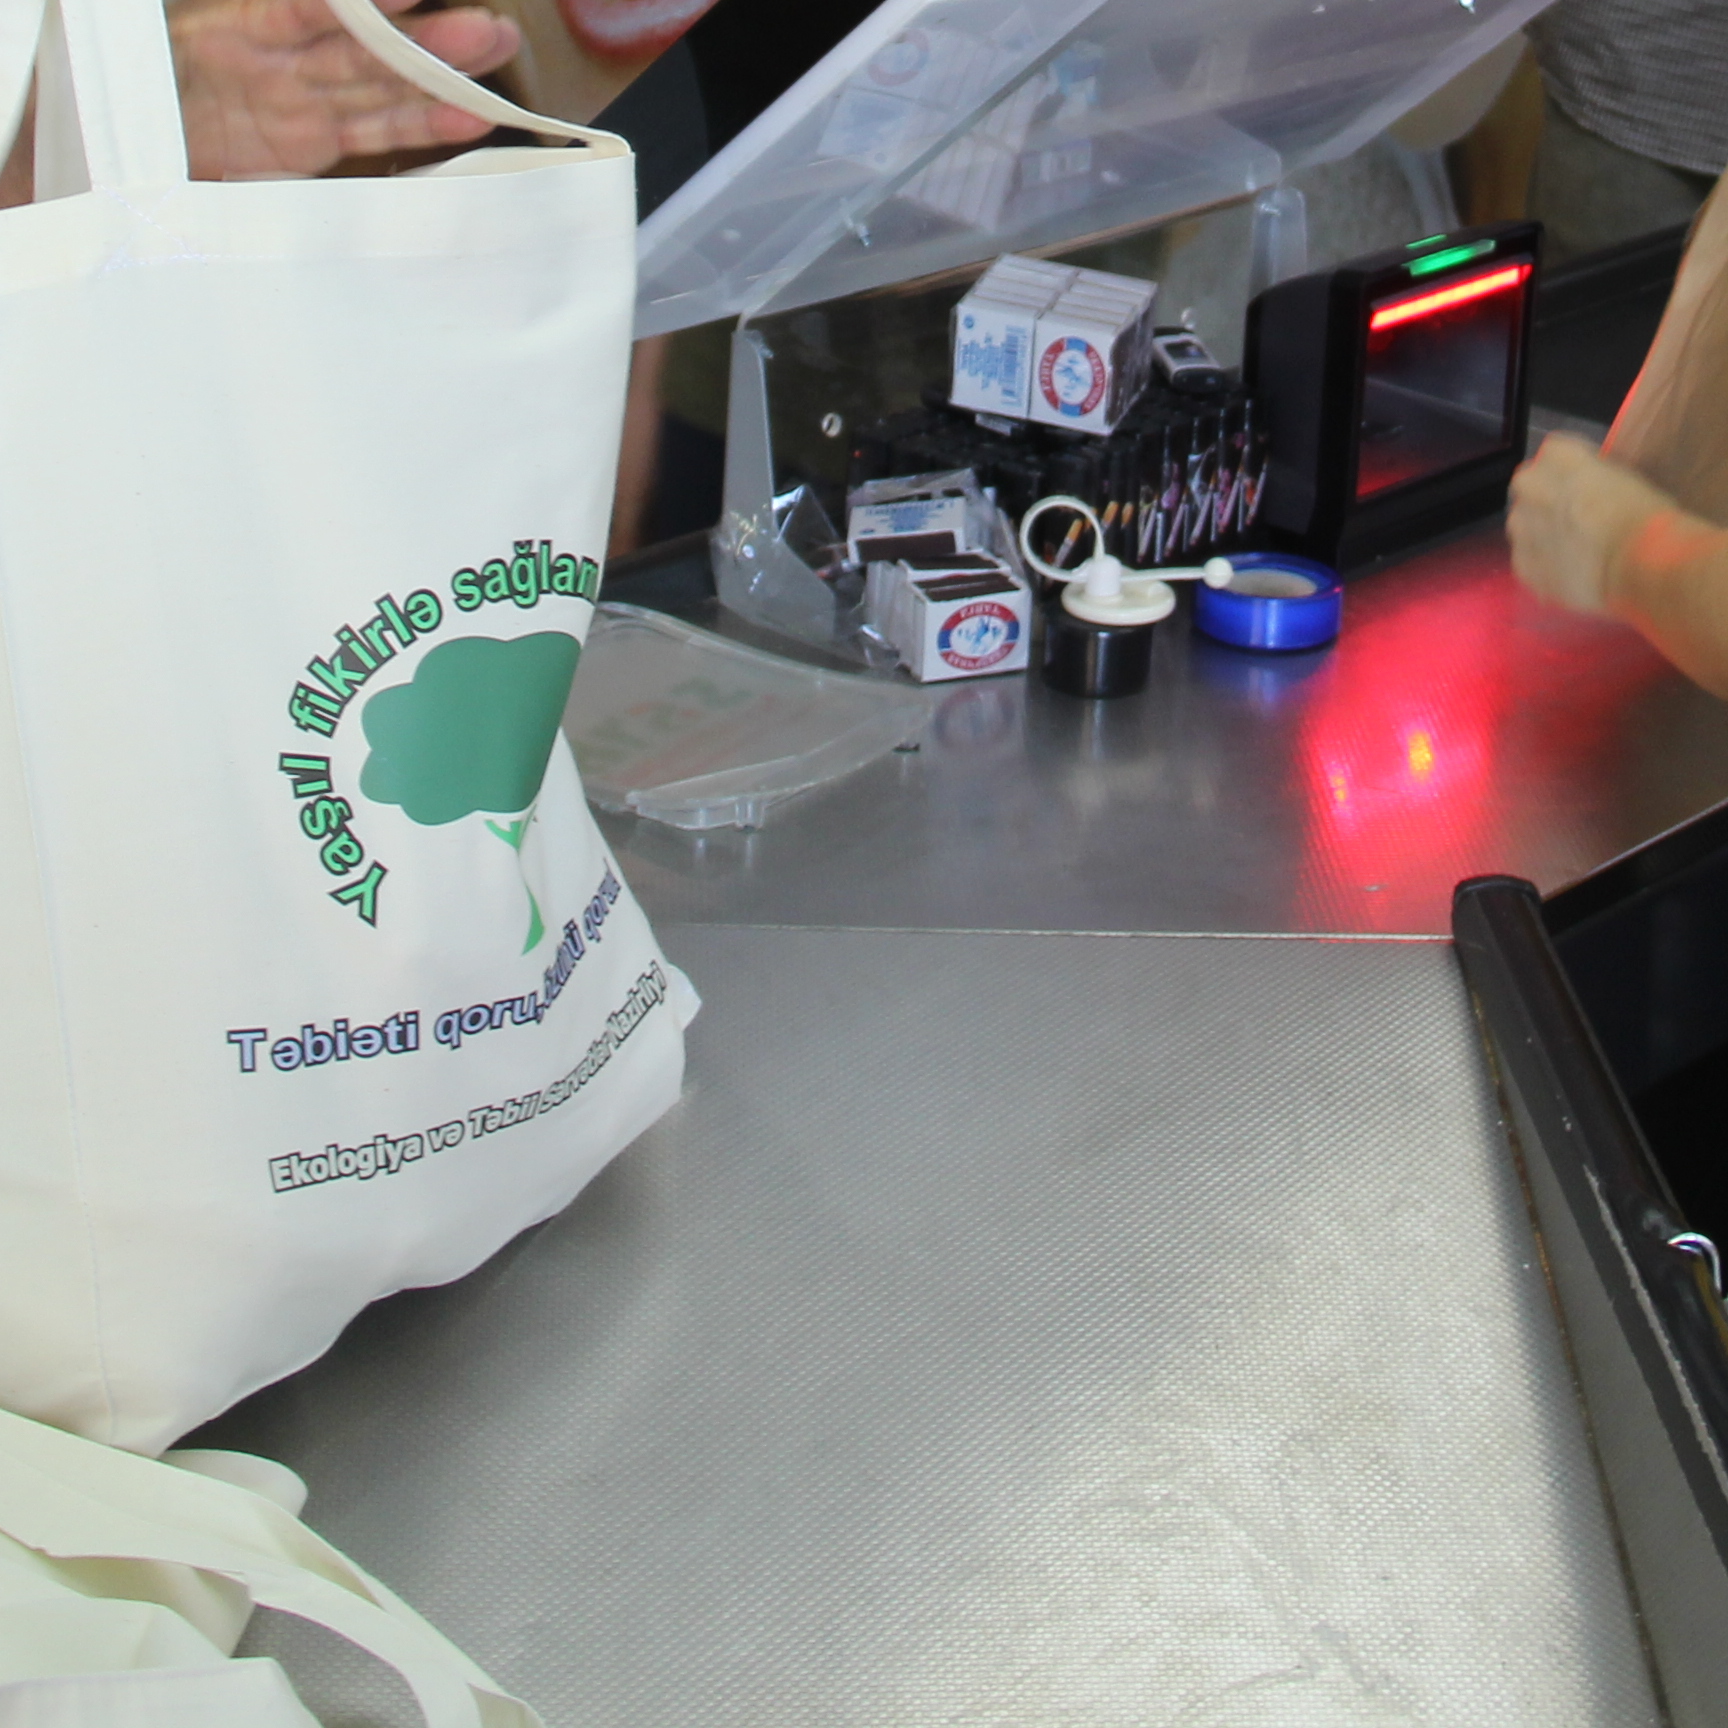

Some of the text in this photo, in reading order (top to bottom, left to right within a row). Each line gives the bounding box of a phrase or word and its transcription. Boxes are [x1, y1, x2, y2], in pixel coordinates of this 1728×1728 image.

[288, 589, 443, 738] fikirlə
[278, 752, 390, 928] Yaşıl
[228, 1007, 421, 1074] Təbiəti
[268, 1131, 424, 1193] Ekologiya
[428, 1119, 466, 1153] və
